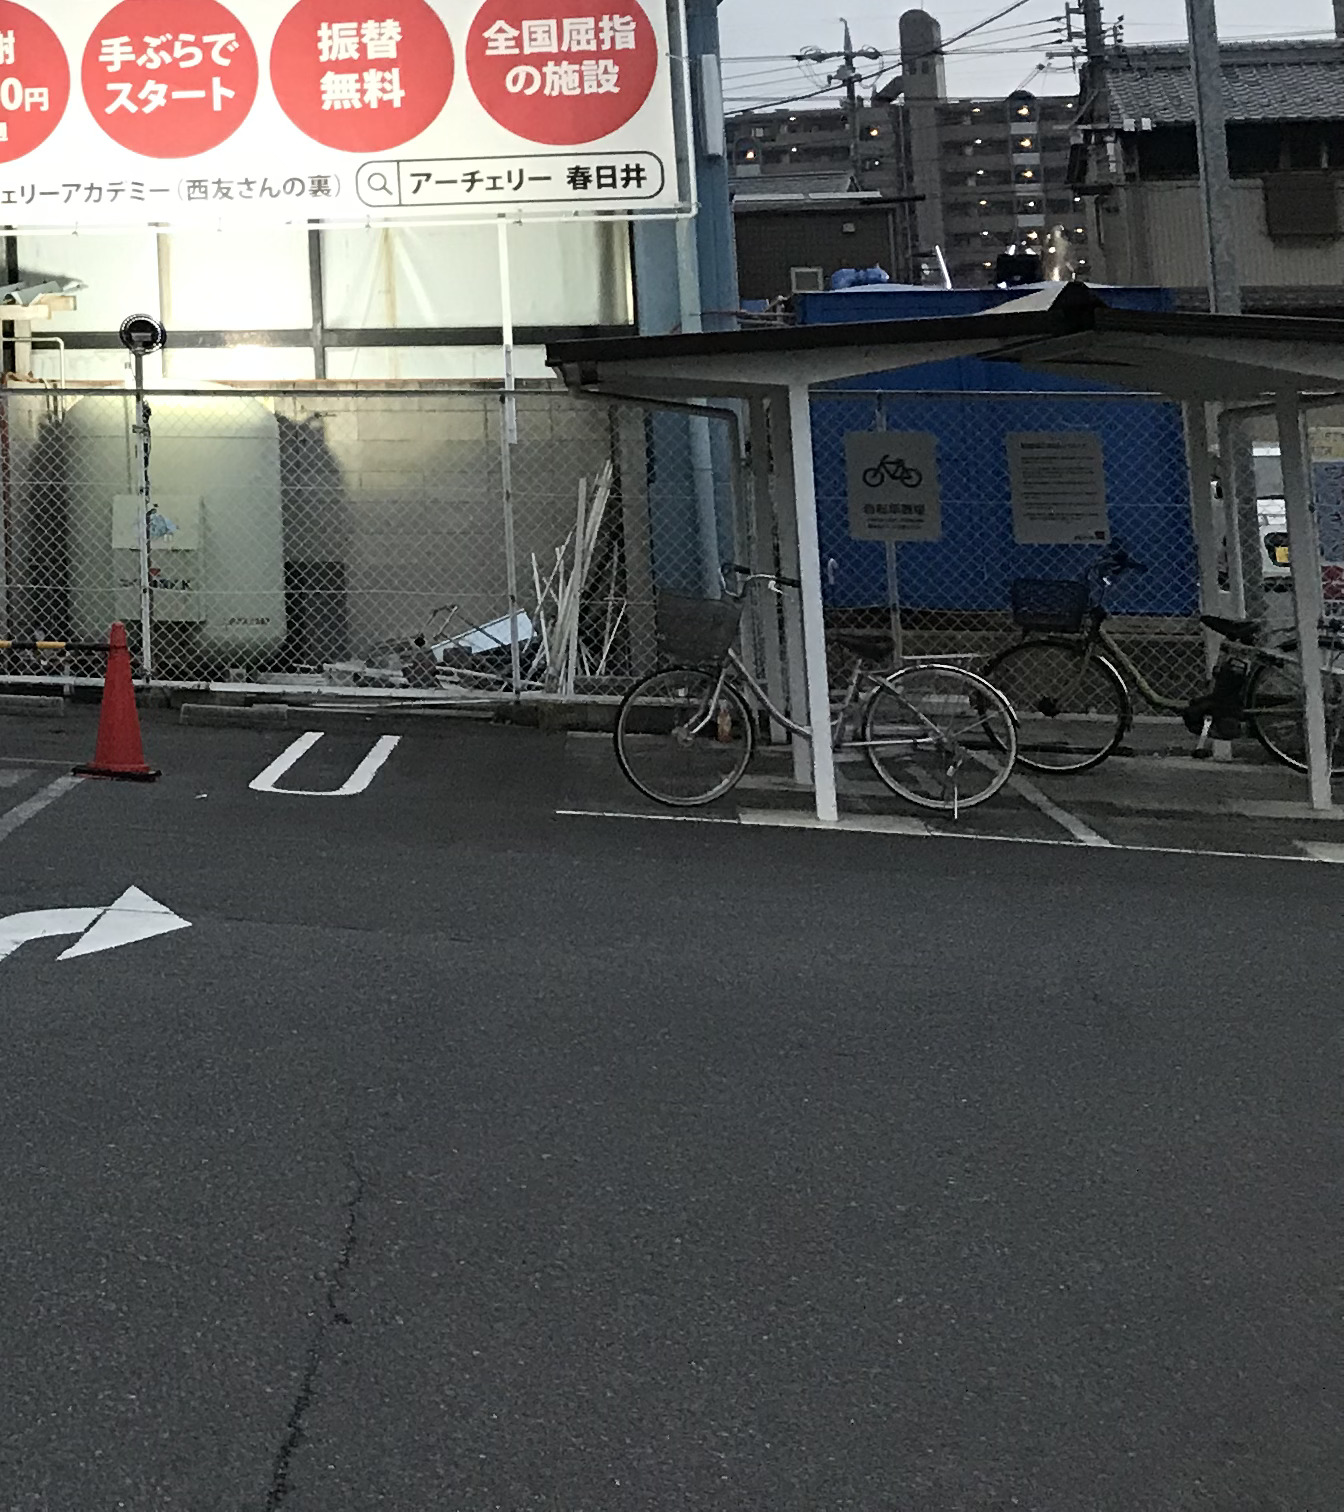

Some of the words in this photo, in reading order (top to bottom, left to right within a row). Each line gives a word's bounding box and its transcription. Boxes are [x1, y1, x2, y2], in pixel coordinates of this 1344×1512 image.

[98, 32, 240, 73] 手ぶらで
[317, 19, 403, 63] 振替
[483, 13, 636, 57] 全国屈指
[104, 76, 236, 115] スタート
[320, 69, 406, 111] 無料
[505, 59, 621, 97] の施設
[410, 169, 552, 194] アーチェリー
[566, 162, 648, 191] 春日井
